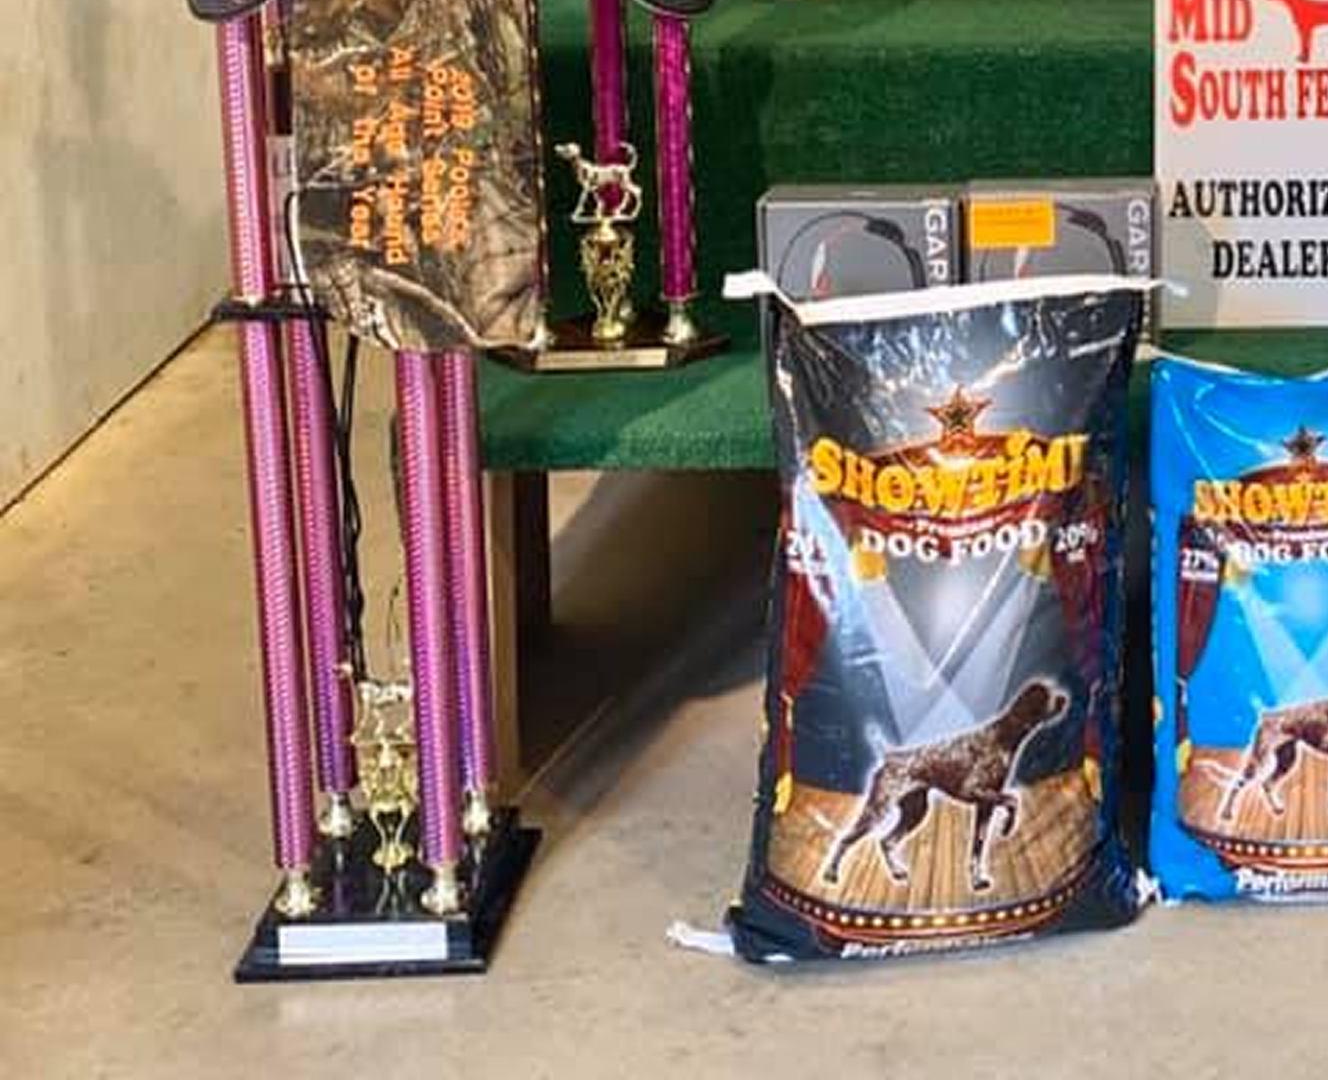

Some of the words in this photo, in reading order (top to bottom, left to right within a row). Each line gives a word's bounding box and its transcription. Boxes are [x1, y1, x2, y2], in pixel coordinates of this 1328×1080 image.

[422, 68, 448, 137] Point
[352, 186, 376, 251] Year
[862, 528, 941, 563] DOG
[950, 519, 1048, 566] FOOD
